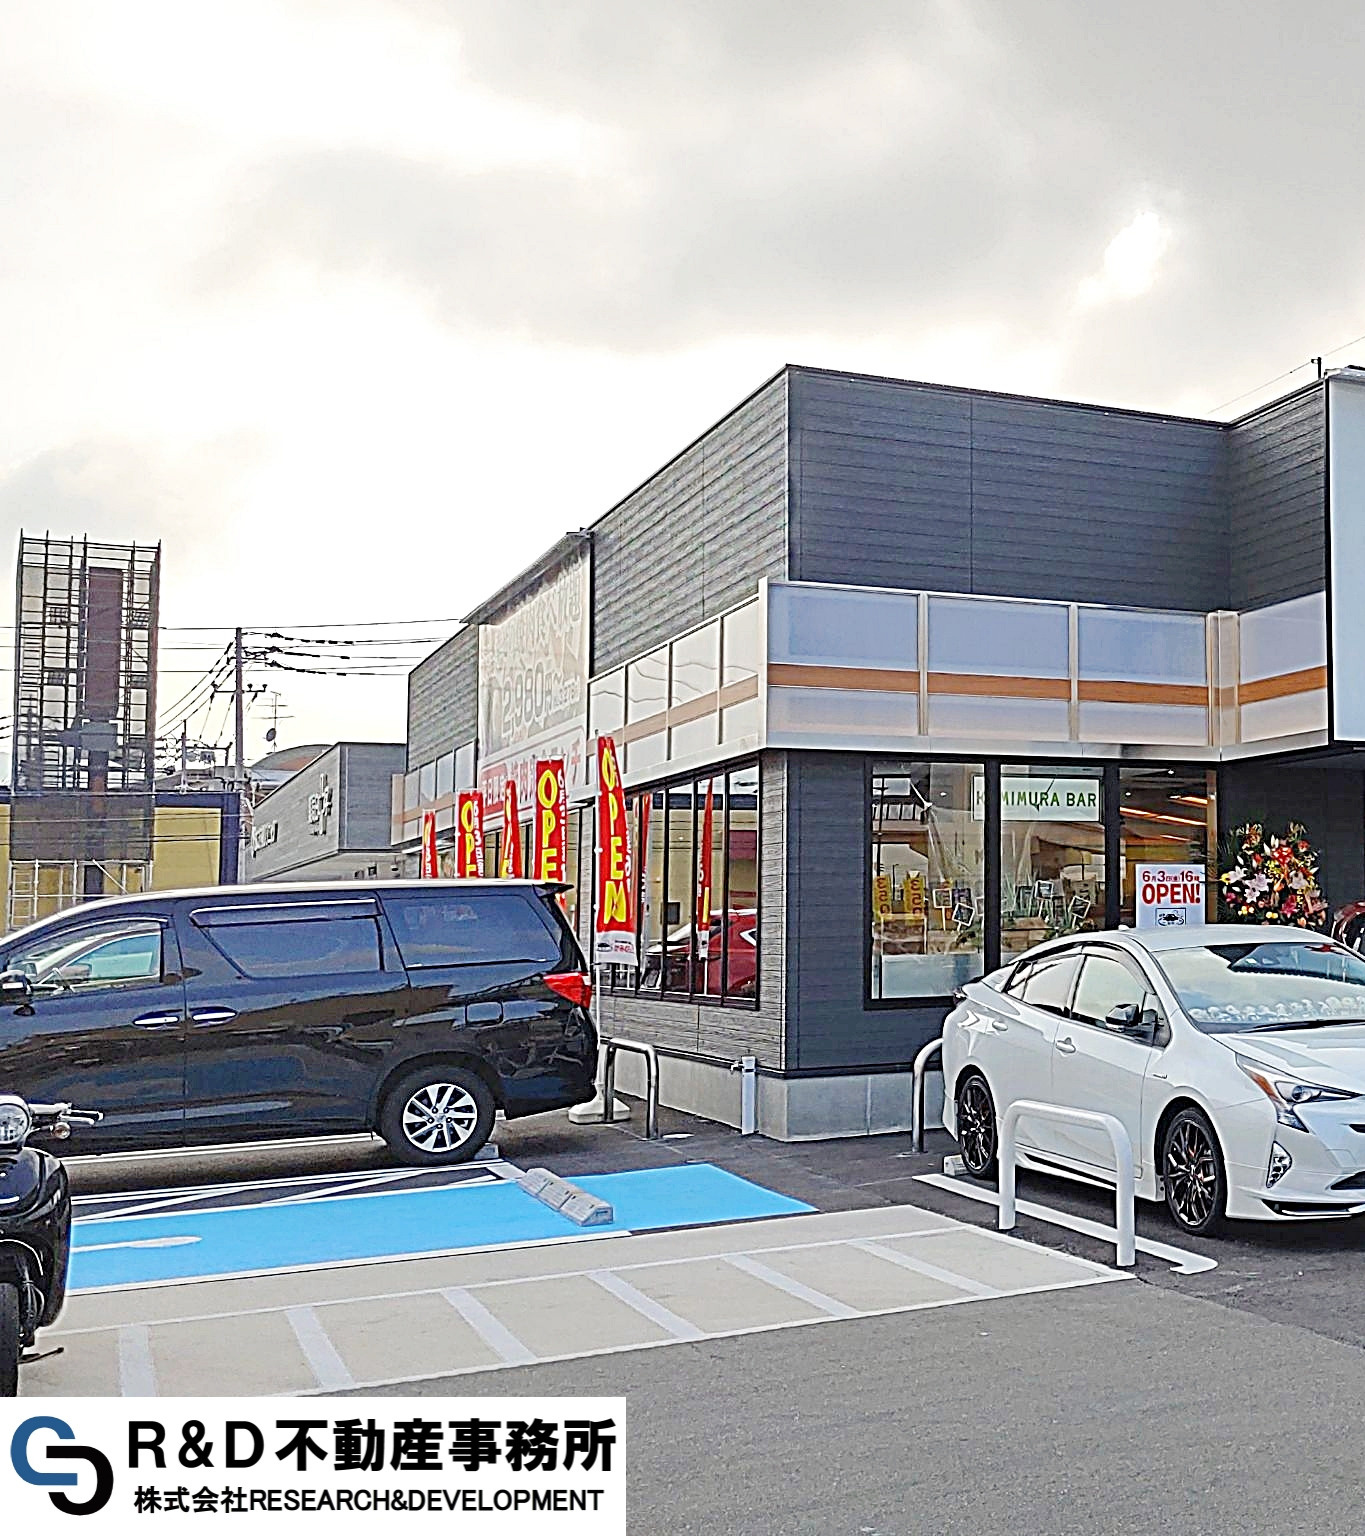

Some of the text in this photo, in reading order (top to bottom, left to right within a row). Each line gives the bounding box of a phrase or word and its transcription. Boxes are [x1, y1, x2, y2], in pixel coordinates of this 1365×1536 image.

[976, 790, 1097, 808] KMIMURA BAR
[537, 769, 559, 881] OPE
[1142, 883, 1201, 904] OPEN!
